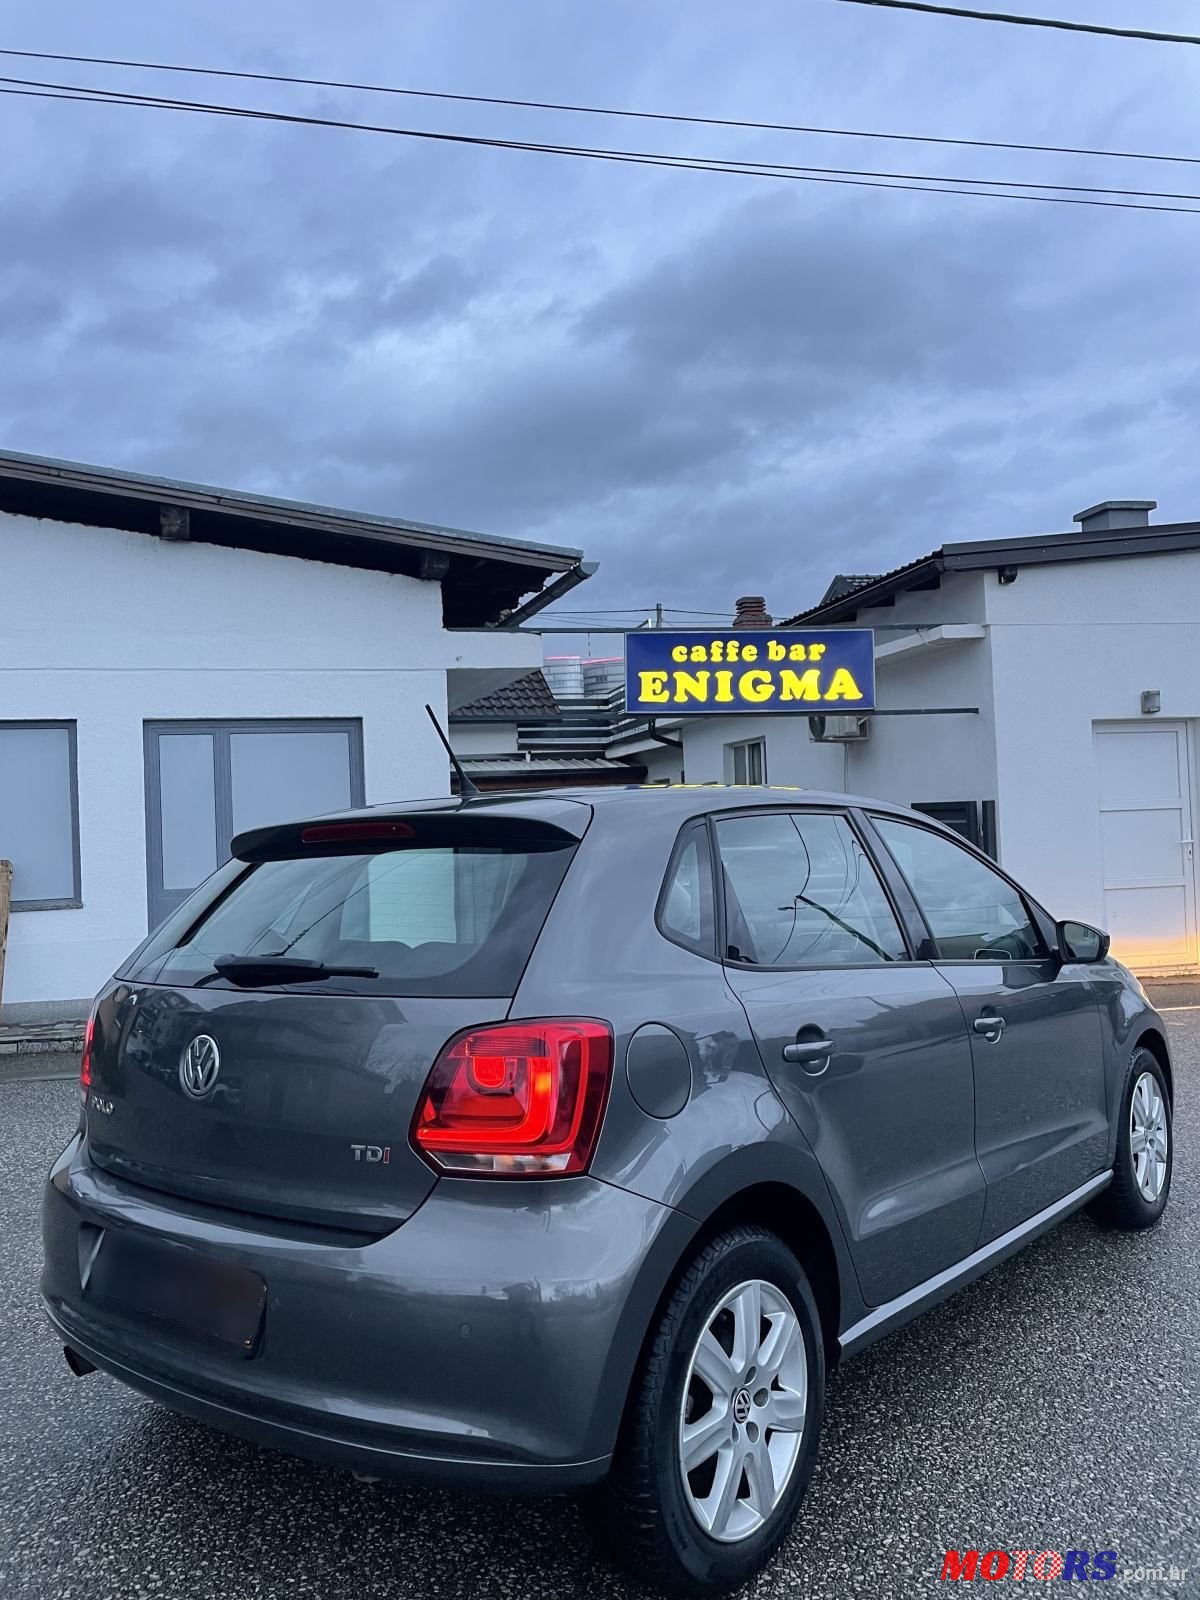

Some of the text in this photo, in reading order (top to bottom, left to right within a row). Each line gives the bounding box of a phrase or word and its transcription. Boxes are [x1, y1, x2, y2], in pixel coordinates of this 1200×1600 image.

[672, 640, 826, 663] caffe bar
[637, 668, 863, 702] ENIGMA
[350, 1144, 391, 1164] TDI
